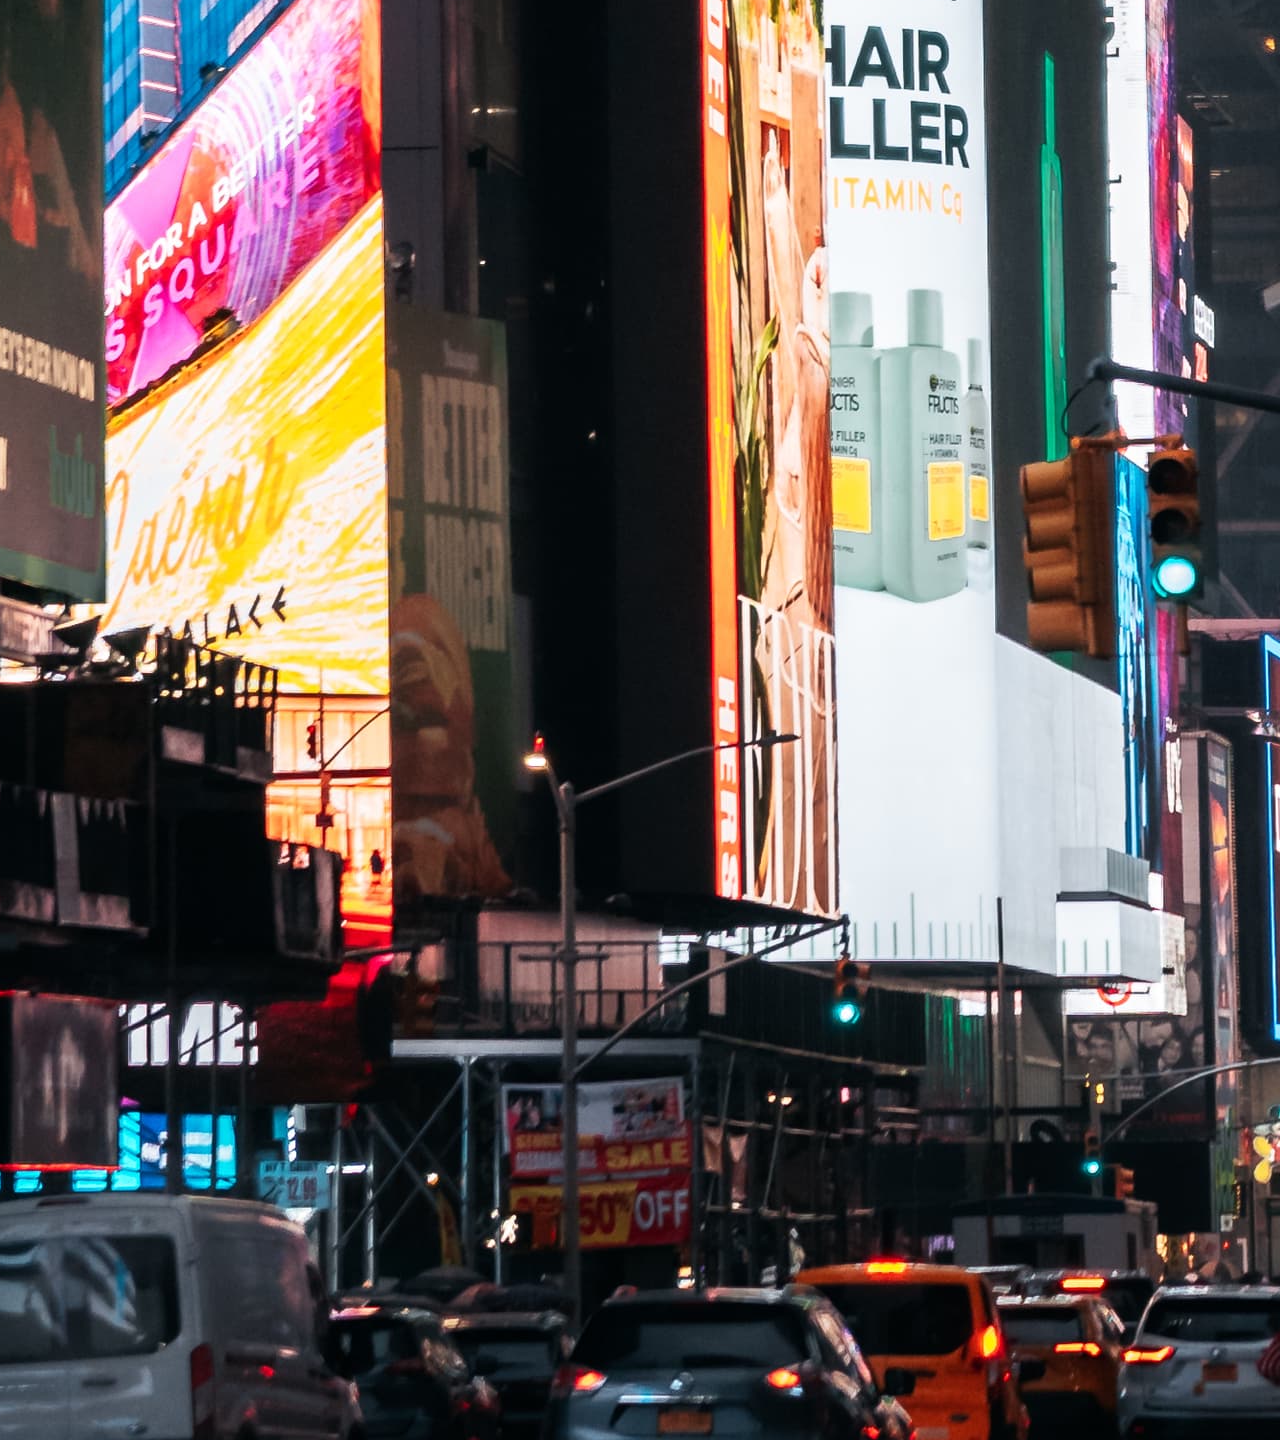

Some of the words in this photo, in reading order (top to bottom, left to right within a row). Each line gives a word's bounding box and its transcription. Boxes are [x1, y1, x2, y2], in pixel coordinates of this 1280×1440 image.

[137, 222, 183, 285] FOR
[187, 200, 208, 238] A
[211, 93, 317, 205] BETTER
[143, 136, 318, 323] SQUARE
[928, 393, 960, 415] FRUCTIS
[605, 1139, 690, 1170] SALE
[634, 1187, 690, 1232] OFF
